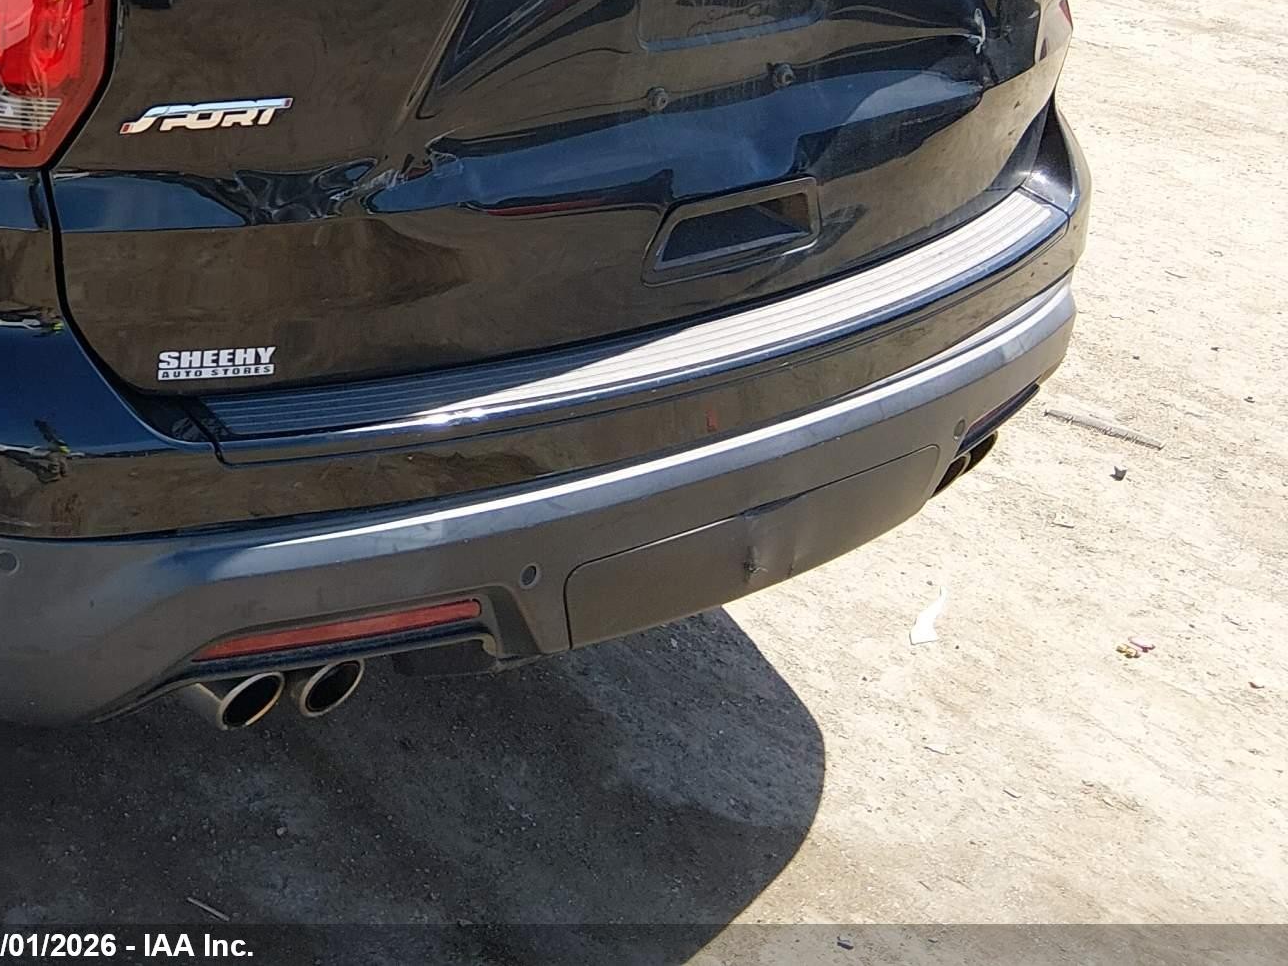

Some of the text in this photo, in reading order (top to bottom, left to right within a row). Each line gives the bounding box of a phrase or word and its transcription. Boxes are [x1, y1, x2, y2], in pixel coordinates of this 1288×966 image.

[120, 97, 293, 134] SPORT
[158, 346, 276, 369] SHEEHY
[161, 365, 271, 379] AUTO STORES
